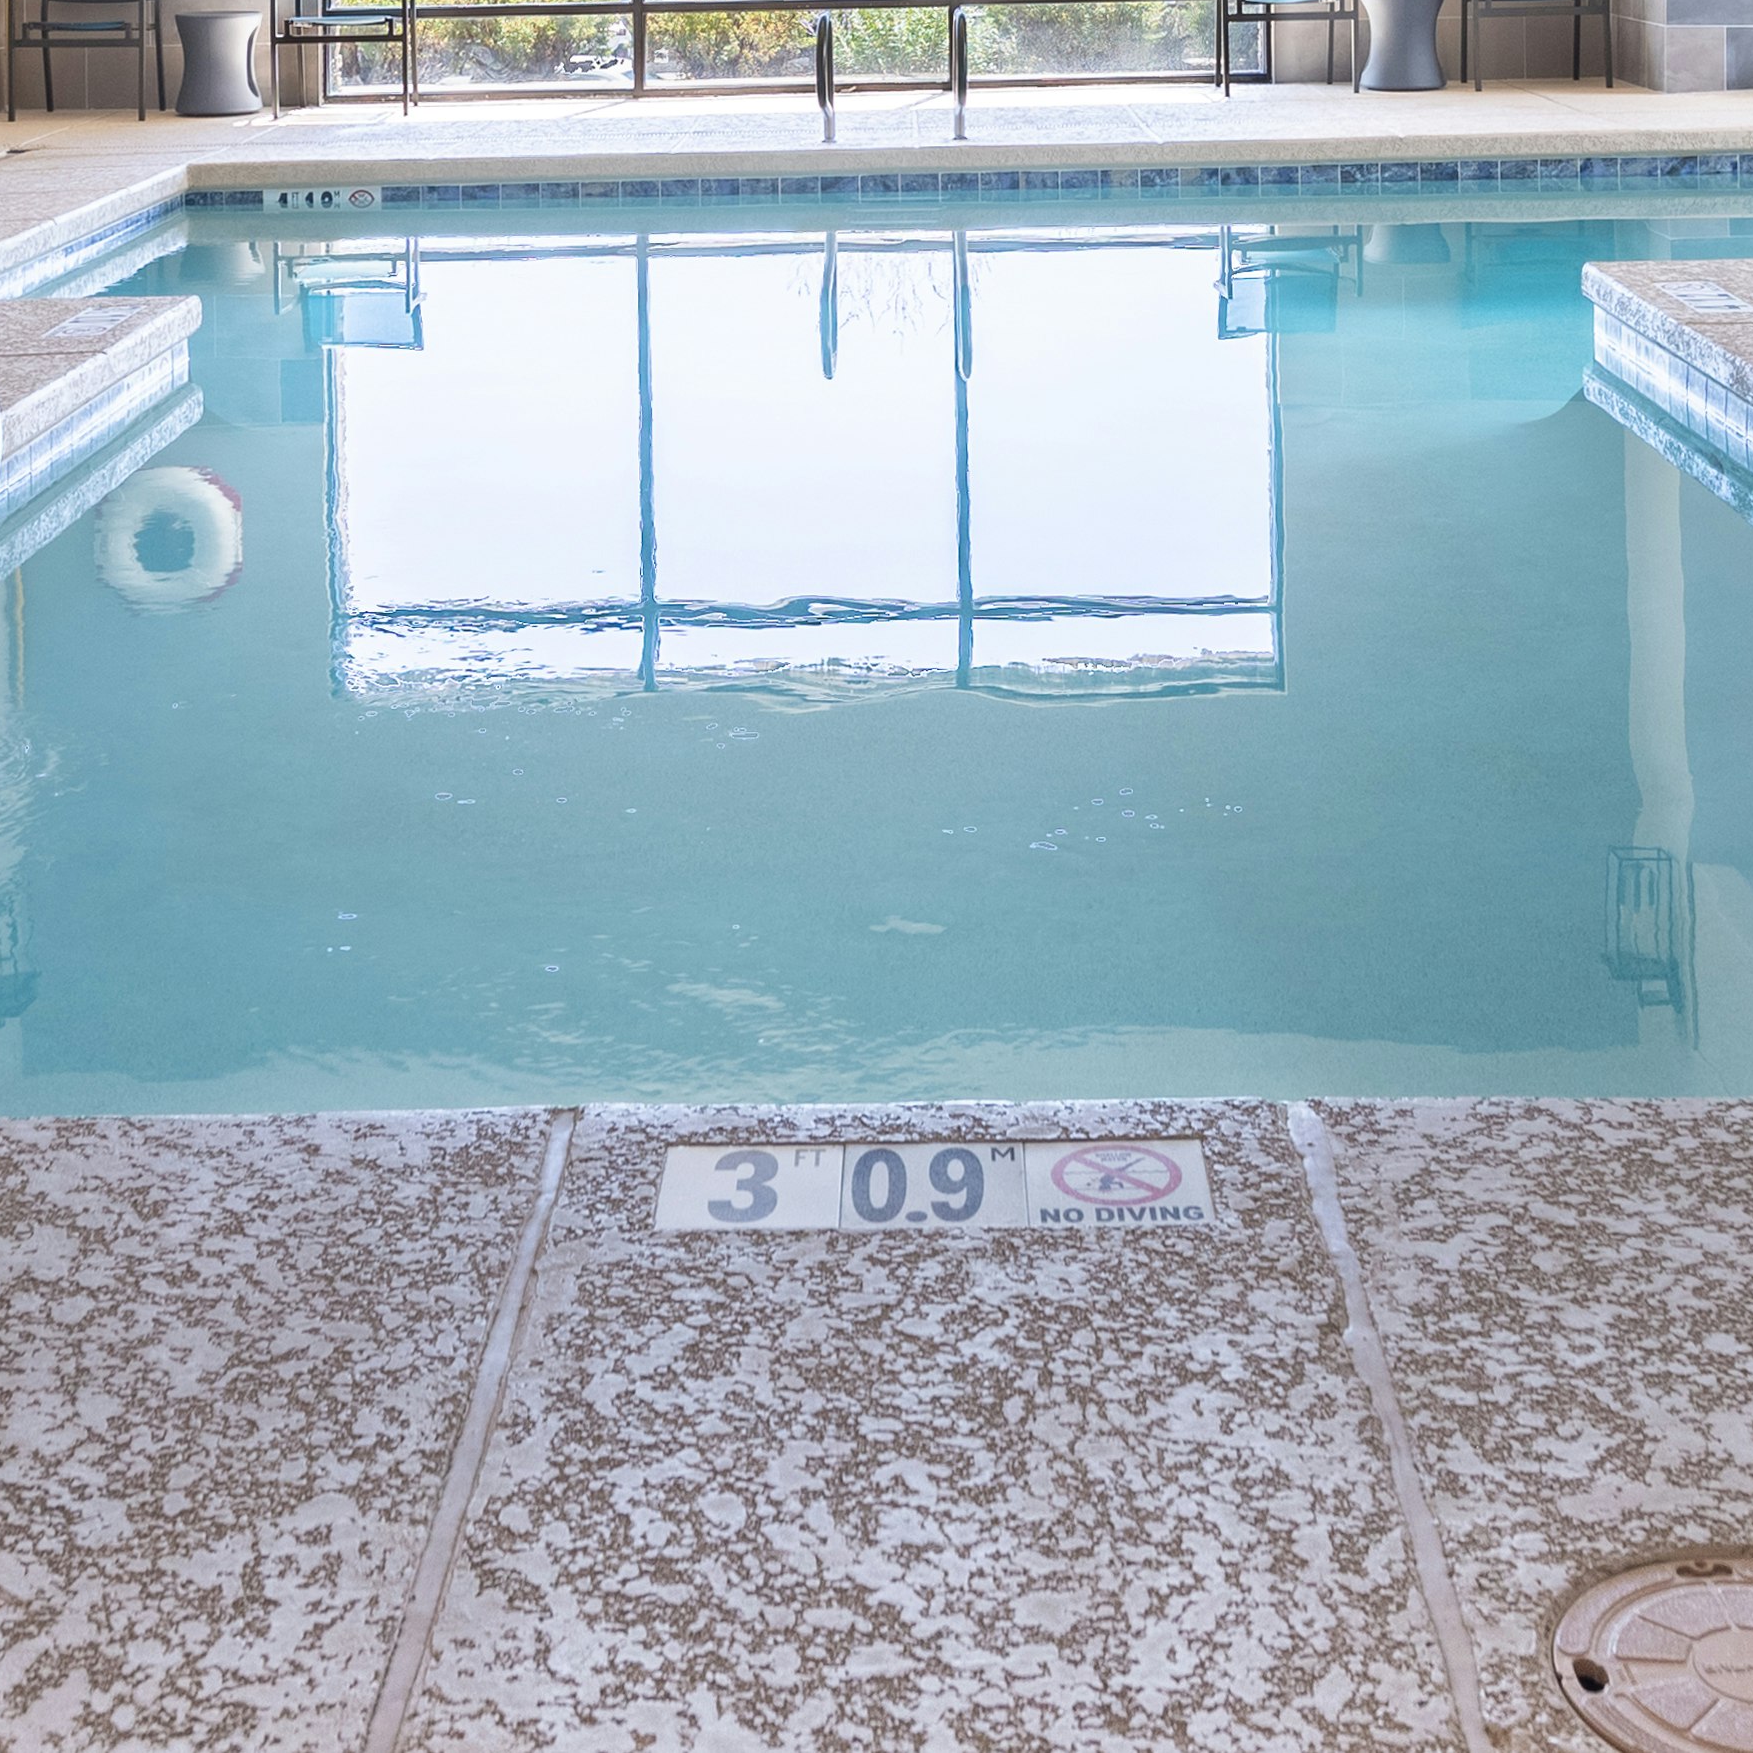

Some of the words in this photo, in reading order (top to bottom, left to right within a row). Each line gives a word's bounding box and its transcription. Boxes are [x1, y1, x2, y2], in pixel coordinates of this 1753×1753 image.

[707, 1149, 778, 1223] 3
[794, 1149, 829, 1168] FT
[850, 1147, 986, 1224] 0.9
[991, 1147, 1016, 1162] M
[1040, 1208, 1084, 1223] NO
[1095, 1206, 1204, 1222] DIVING
